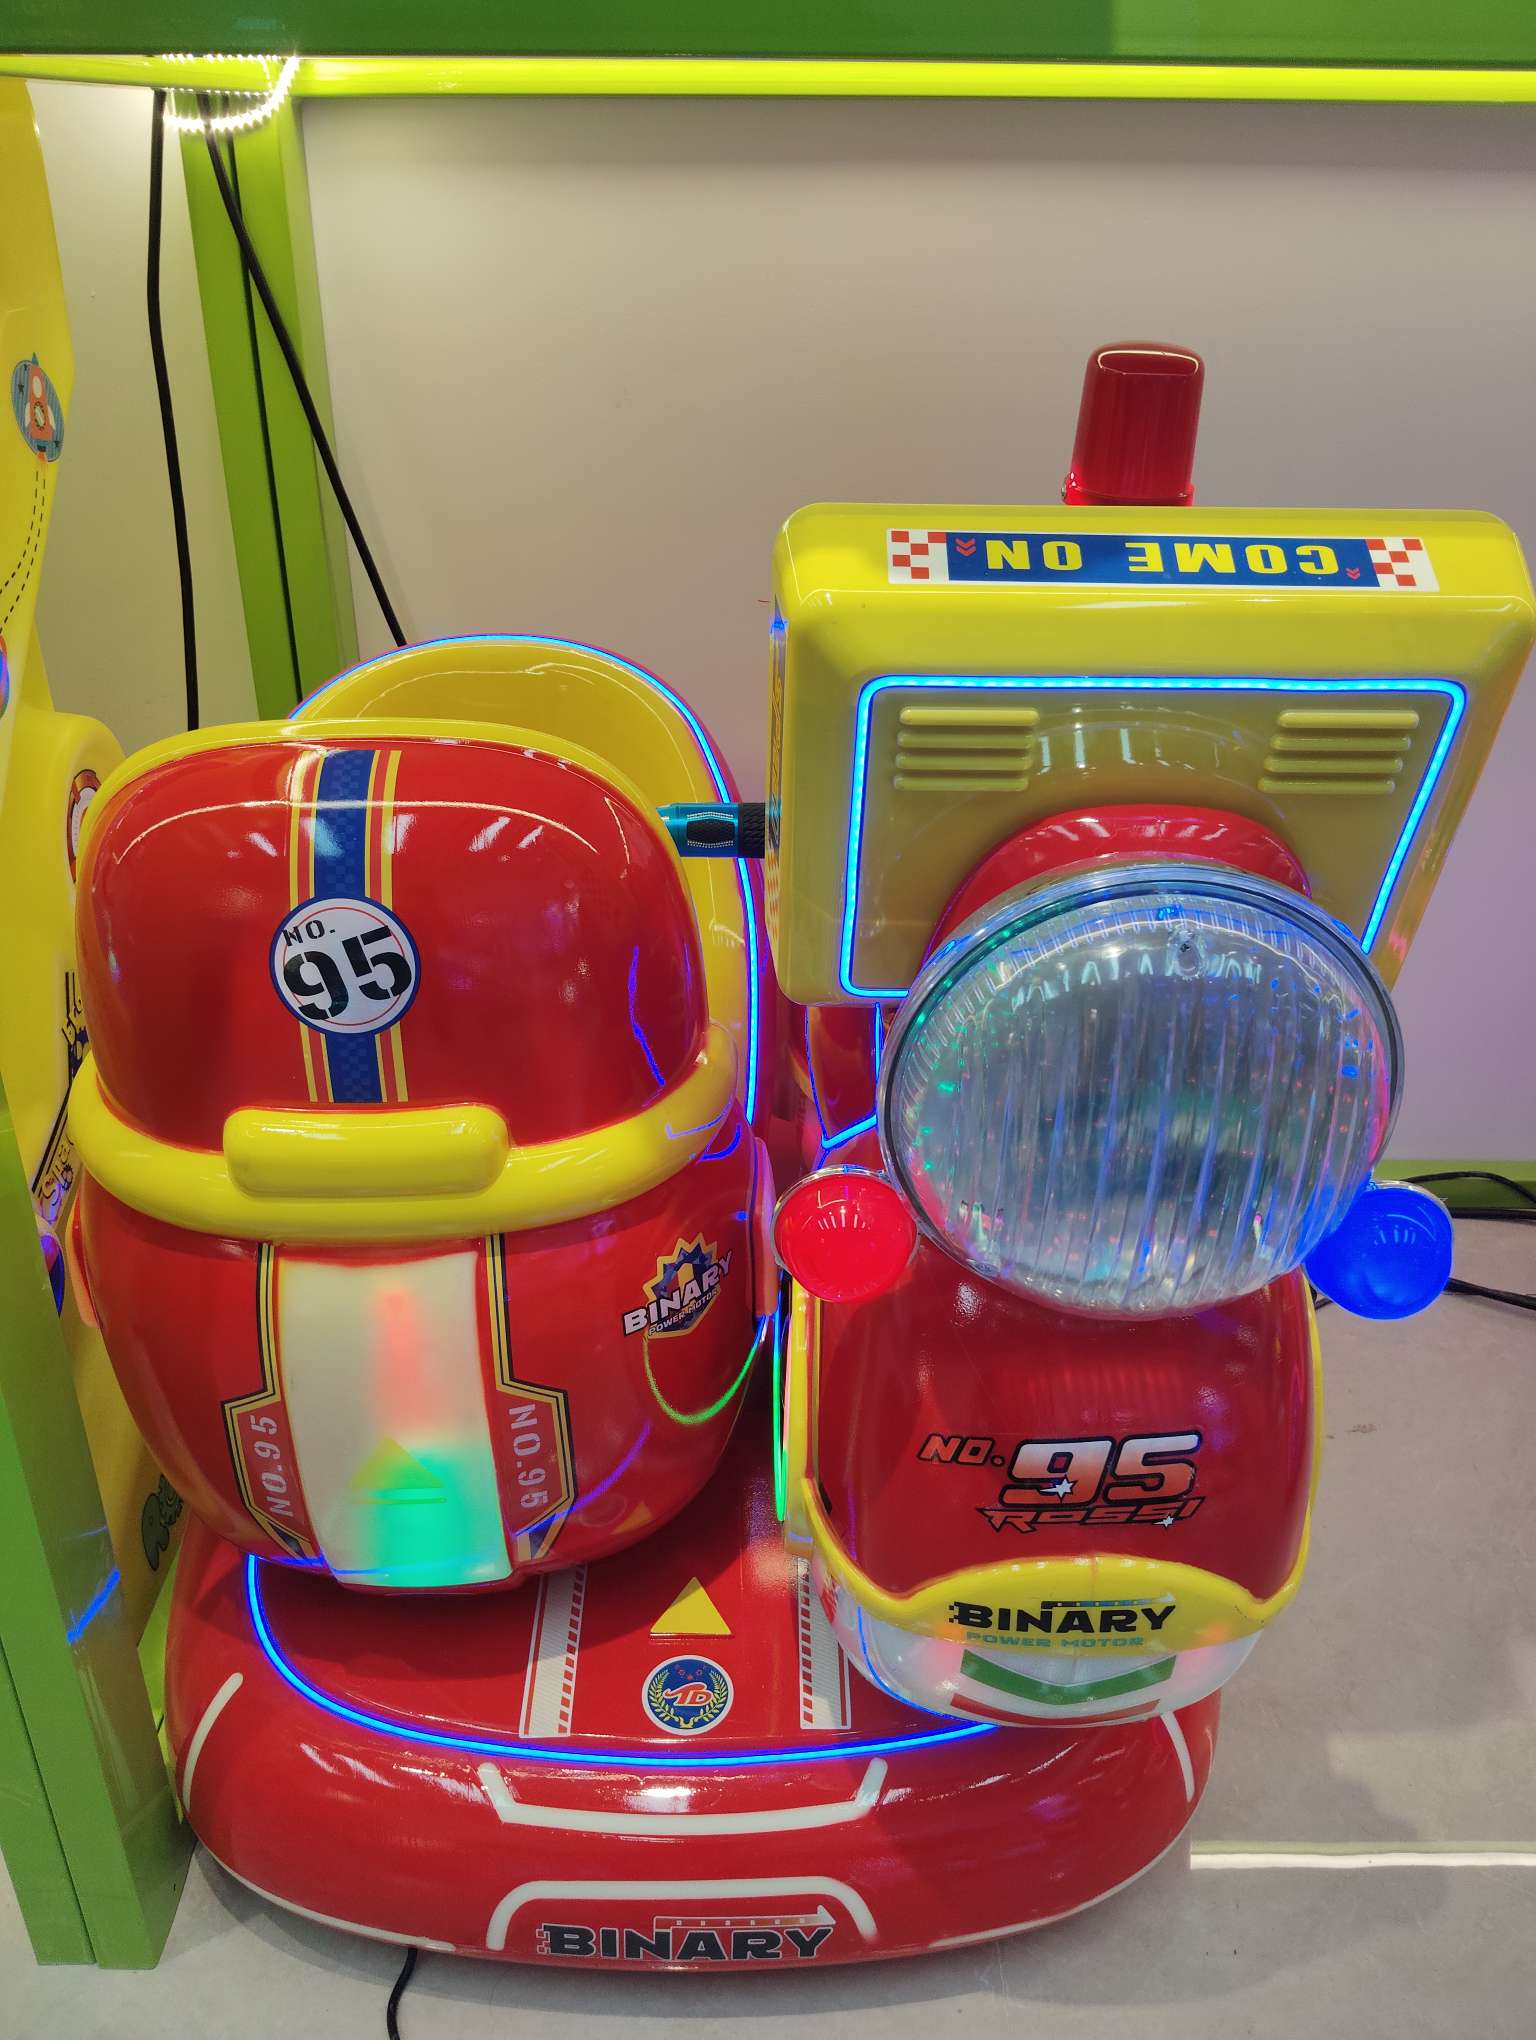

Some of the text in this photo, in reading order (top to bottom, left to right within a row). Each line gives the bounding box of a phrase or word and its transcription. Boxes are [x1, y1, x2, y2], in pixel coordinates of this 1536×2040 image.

[985, 539, 1339, 575] COME ON
[282, 919, 336, 947] NO.
[283, 925, 412, 1020] 95
[622, 1248, 733, 1337] BINARY
[648, 1288, 721, 1337] POWER MOTOR
[250, 1414, 294, 1517] NO.95
[508, 1404, 548, 1510] NO.95
[916, 1430, 1203, 1508] NO. 95
[949, 1600, 1176, 1634] BINARY
[966, 1631, 1145, 1649] POWER MOTOR
[536, 1921, 835, 1961] BINARY
